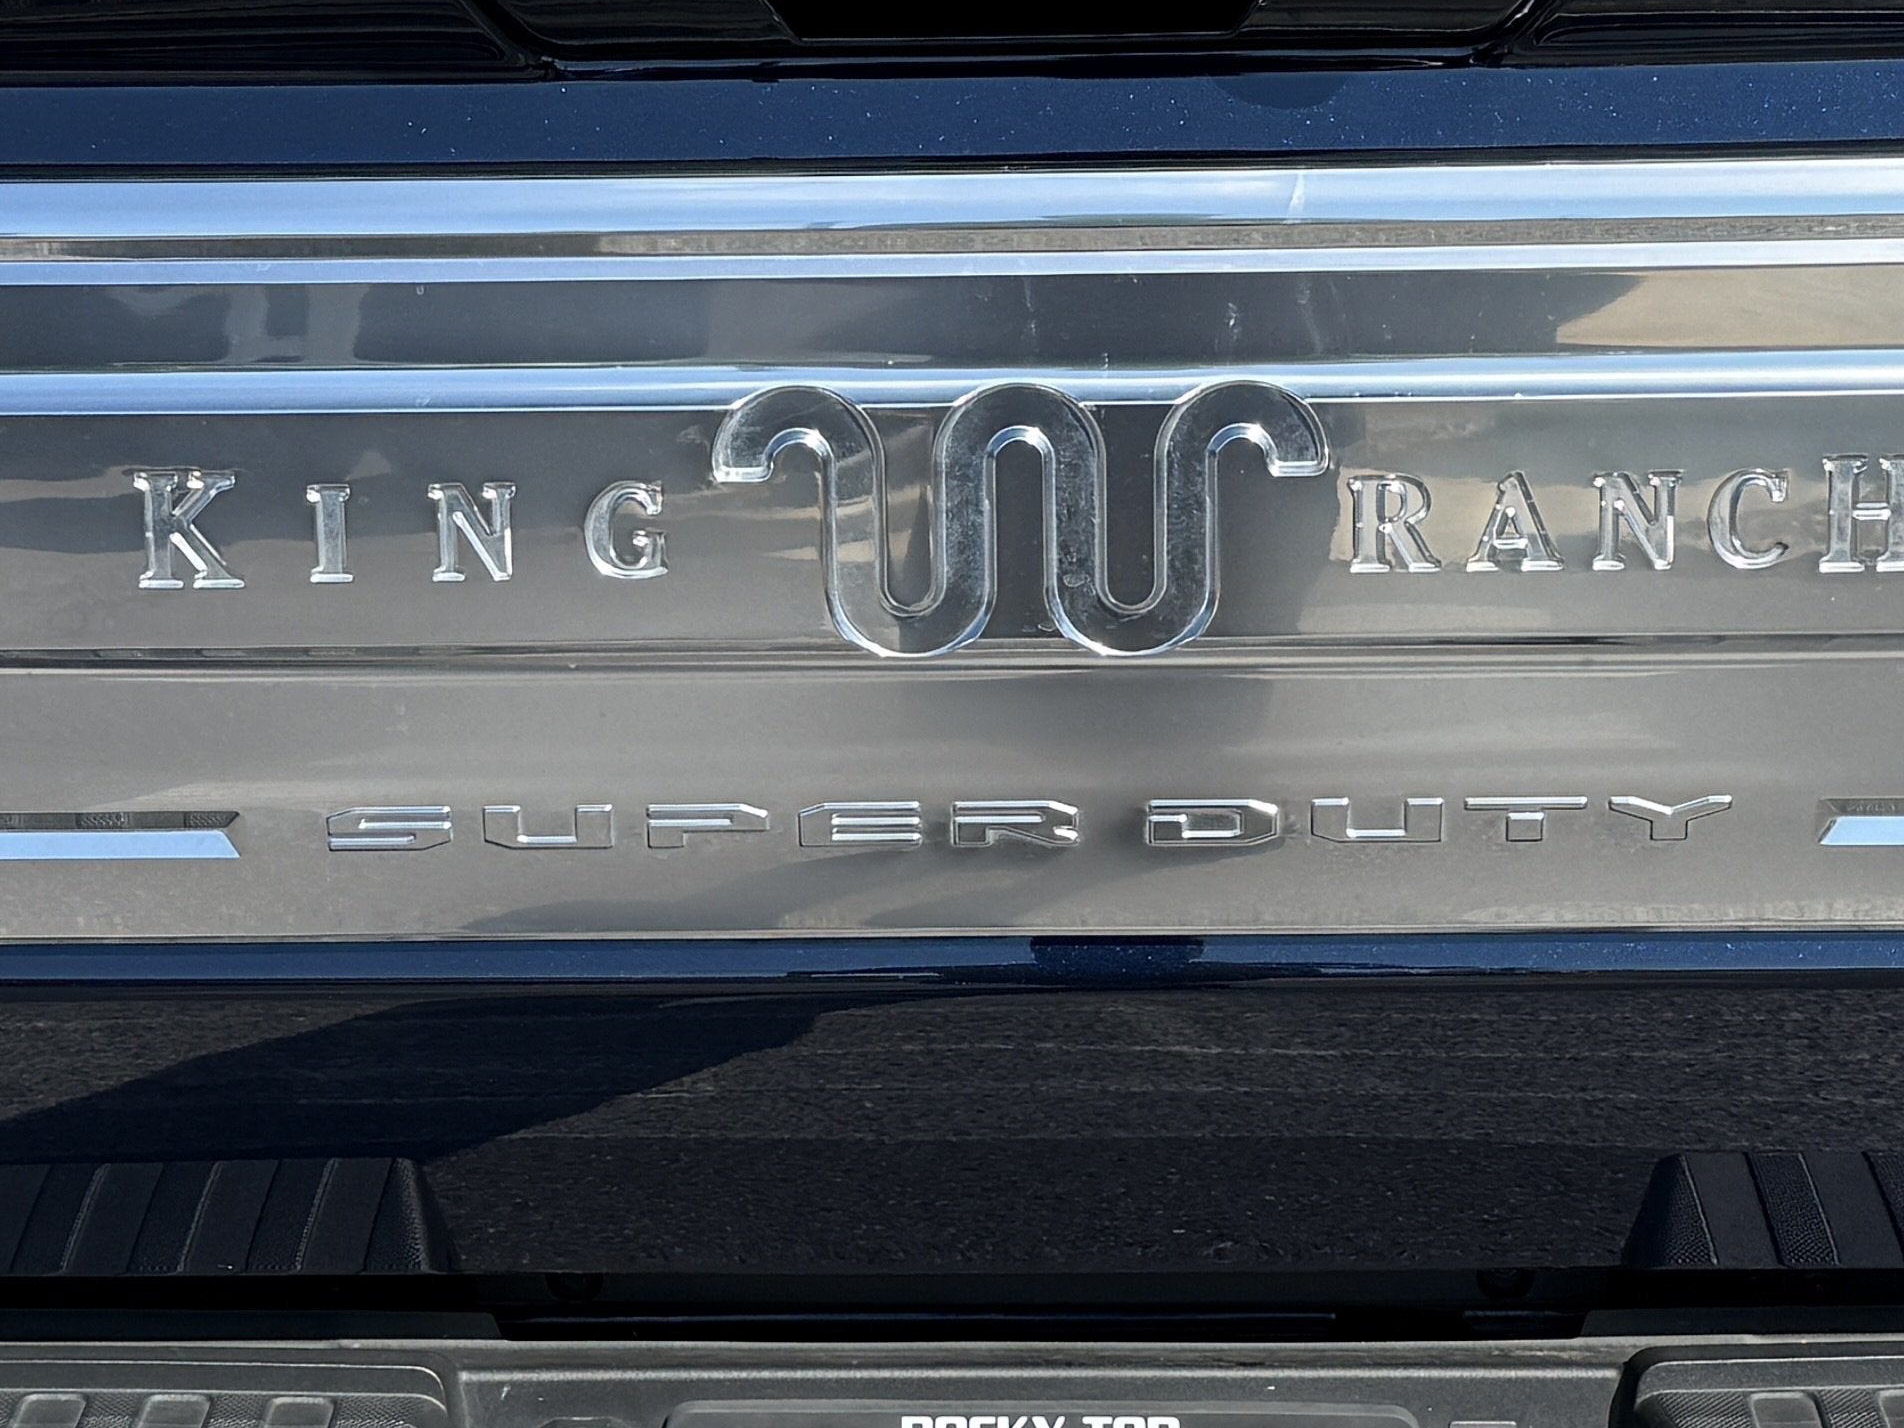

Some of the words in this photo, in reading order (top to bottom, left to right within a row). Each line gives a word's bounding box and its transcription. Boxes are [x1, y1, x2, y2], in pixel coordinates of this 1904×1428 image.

[132, 470, 669, 589] KING
[325, 799, 1080, 851] SUPER
[1143, 794, 1733, 848] DUTY
